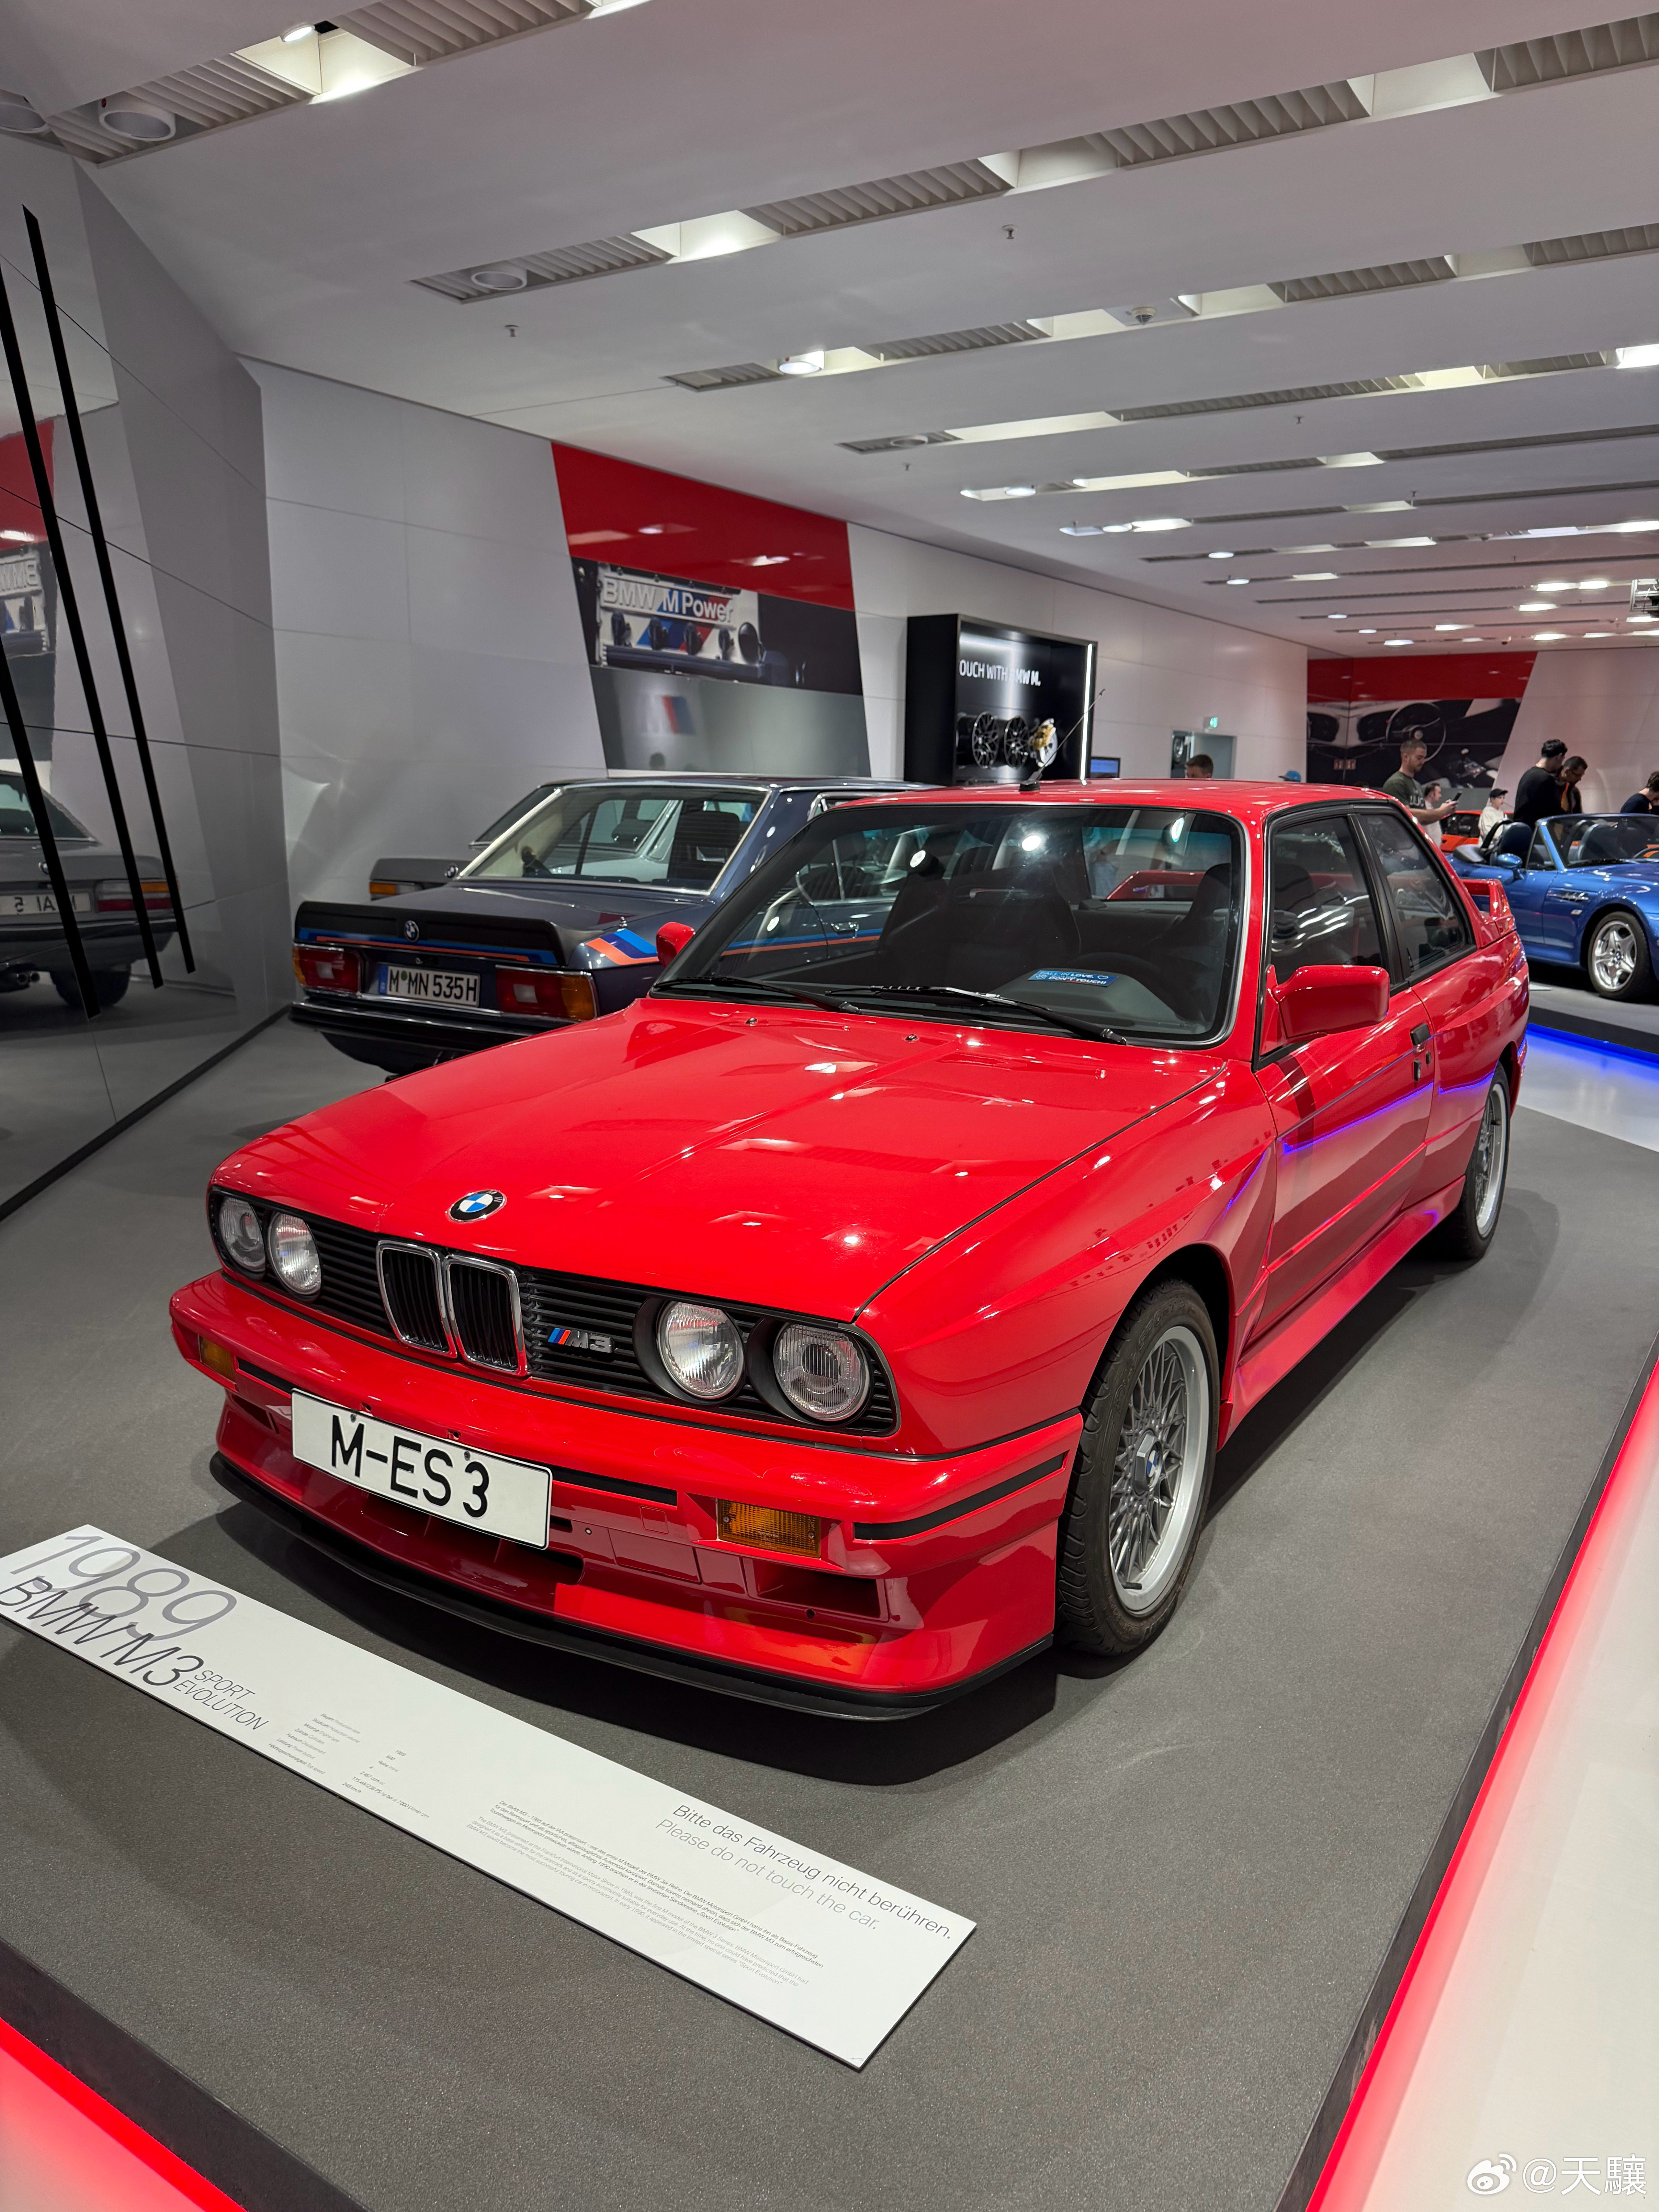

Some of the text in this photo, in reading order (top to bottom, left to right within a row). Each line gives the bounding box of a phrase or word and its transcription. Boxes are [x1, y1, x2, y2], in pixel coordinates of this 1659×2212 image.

[603, 581, 733, 623] BMW M Power
[433, 974, 477, 1002] 535H
[565, 1329, 612, 1353] M3
[331, 1414, 489, 1518] M-ES 3
[10, 1536, 237, 1641] 1989
[0, 1576, 204, 1686] BMW M3
[173, 1681, 269, 1730] EVOLUTION
[195, 1670, 256, 1700] SPORT
[656, 1819, 879, 1930] Please do not touch the car.
[673, 1805, 951, 1939] Bitte das Fahrzeug nicht berühren.
